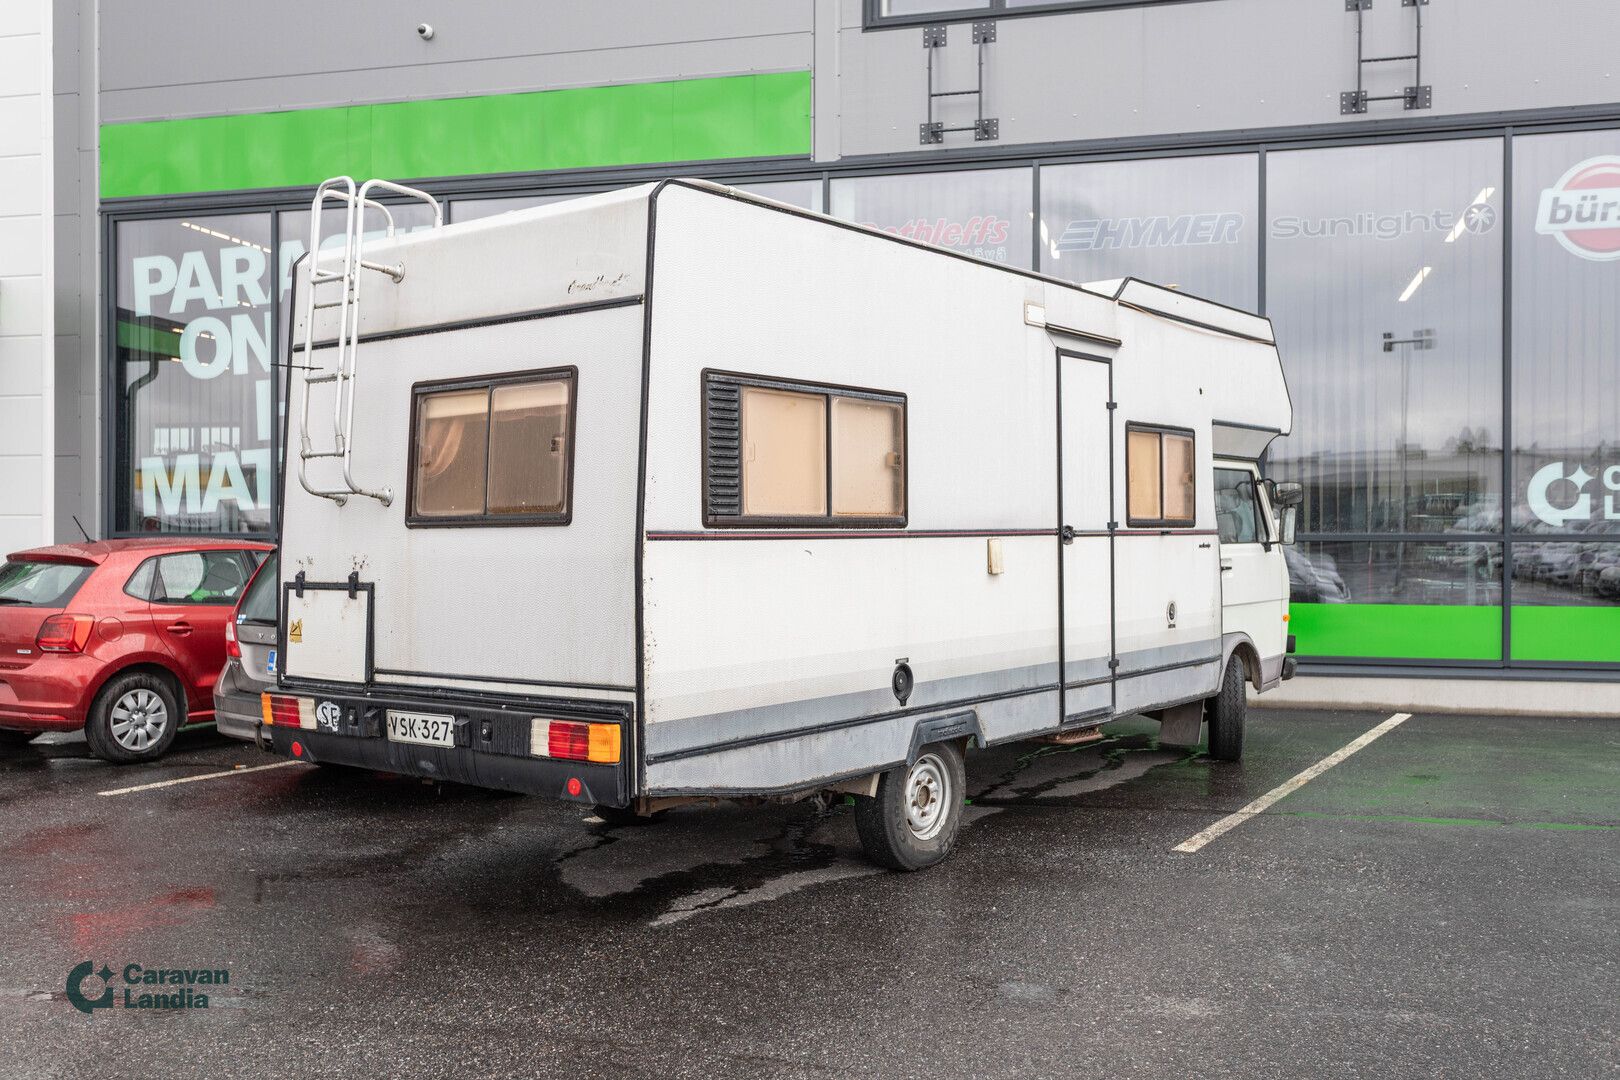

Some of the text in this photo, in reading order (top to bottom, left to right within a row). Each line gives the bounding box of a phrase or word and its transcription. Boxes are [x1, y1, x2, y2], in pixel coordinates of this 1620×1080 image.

[1271, 208, 1454, 240] Sunlight
[1548, 195, 1620, 224] bür
[1091, 211, 1245, 250] HYMER
